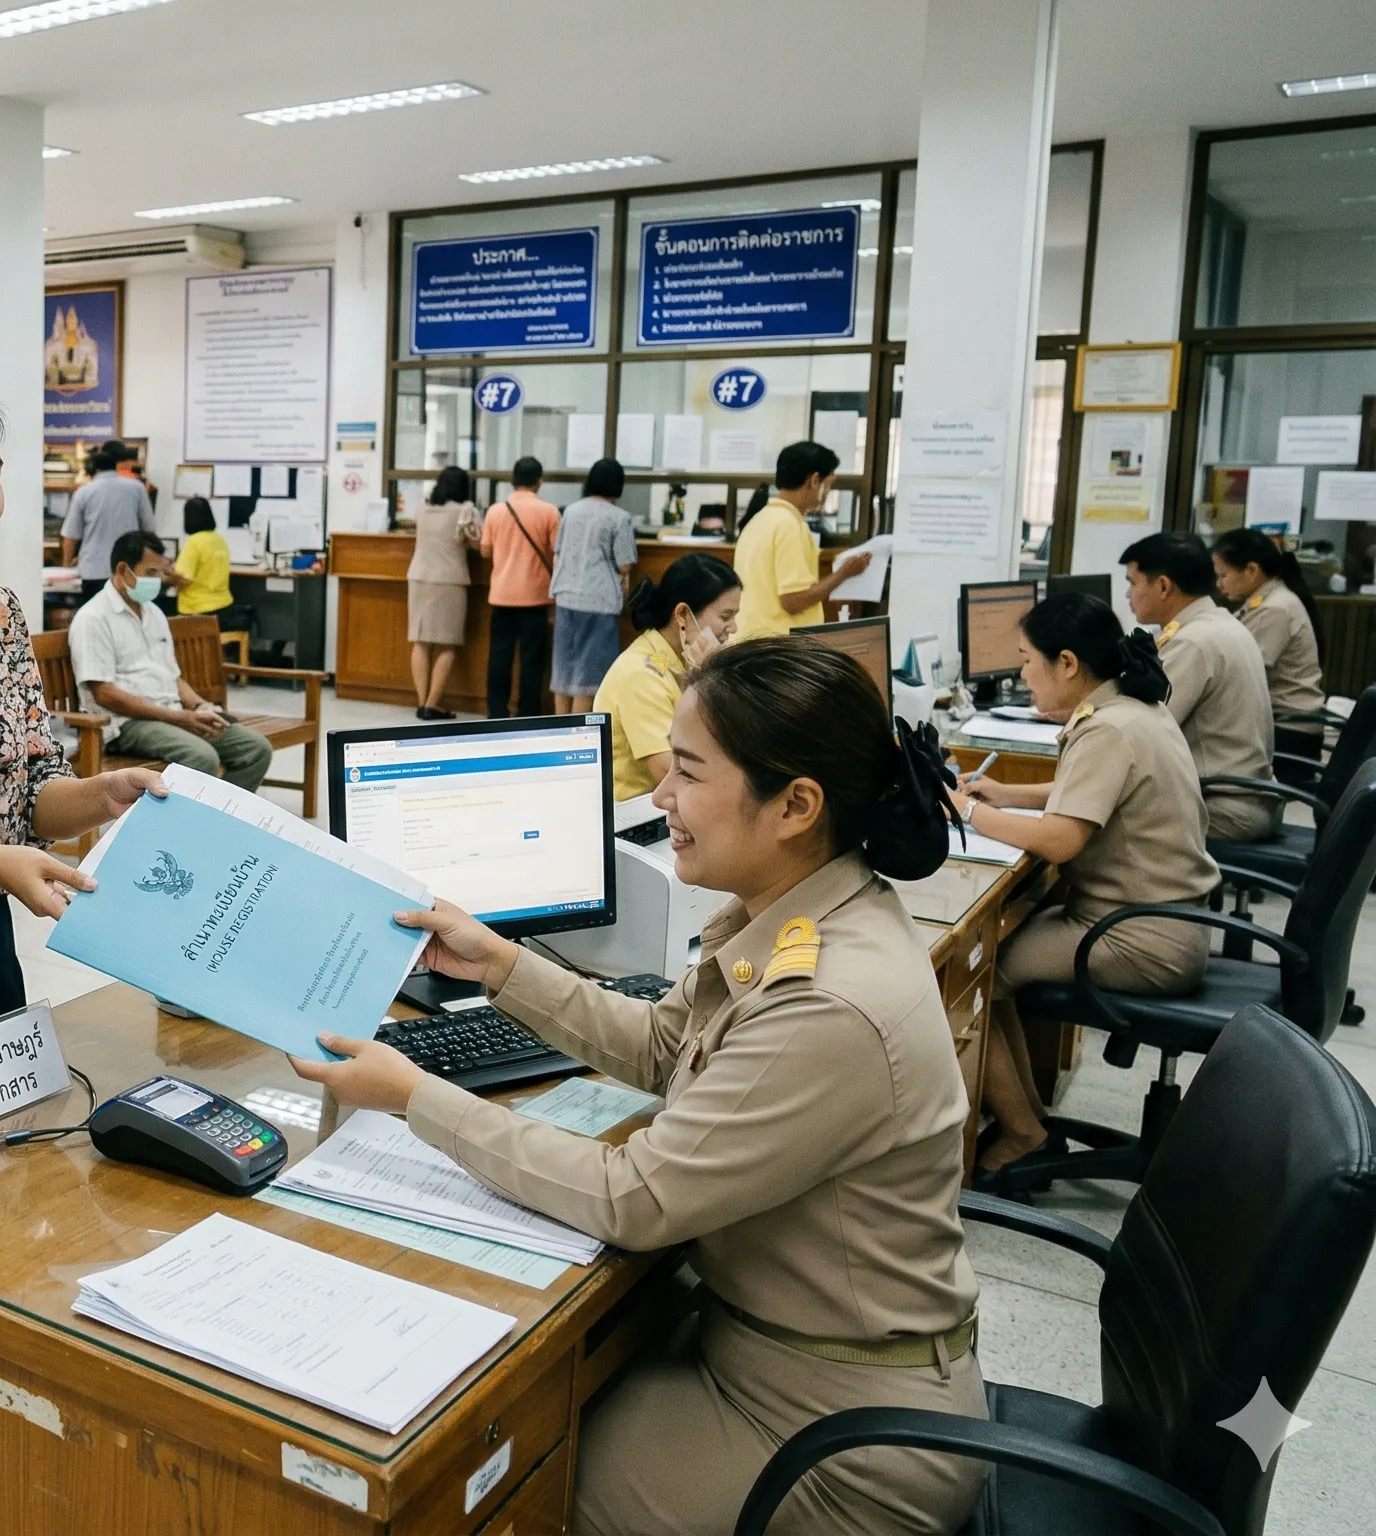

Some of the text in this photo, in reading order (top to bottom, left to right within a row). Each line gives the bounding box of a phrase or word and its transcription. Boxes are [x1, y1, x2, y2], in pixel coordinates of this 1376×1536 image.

[481, 382, 516, 409] #7
[717, 375, 758, 403] #7
[180, 854, 260, 962] สำเนาทะเบียนบ้าน
[206, 932, 236, 974] (HOUSE
